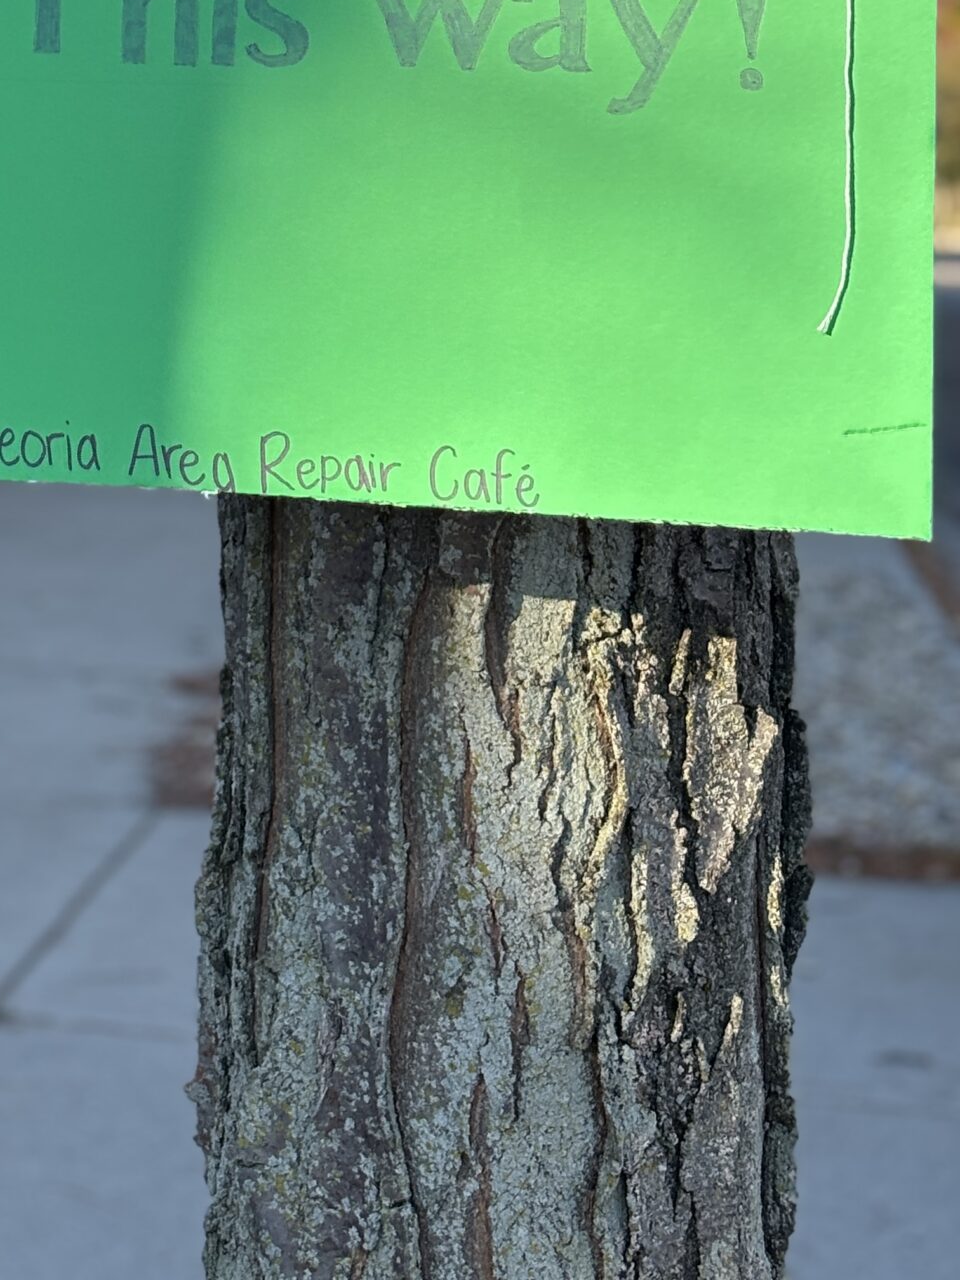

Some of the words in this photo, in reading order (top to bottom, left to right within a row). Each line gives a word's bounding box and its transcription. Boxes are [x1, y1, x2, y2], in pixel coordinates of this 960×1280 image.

[128, 423, 237, 493] Area
[258, 431, 402, 494] Repair
[428, 445, 541, 510] Café
